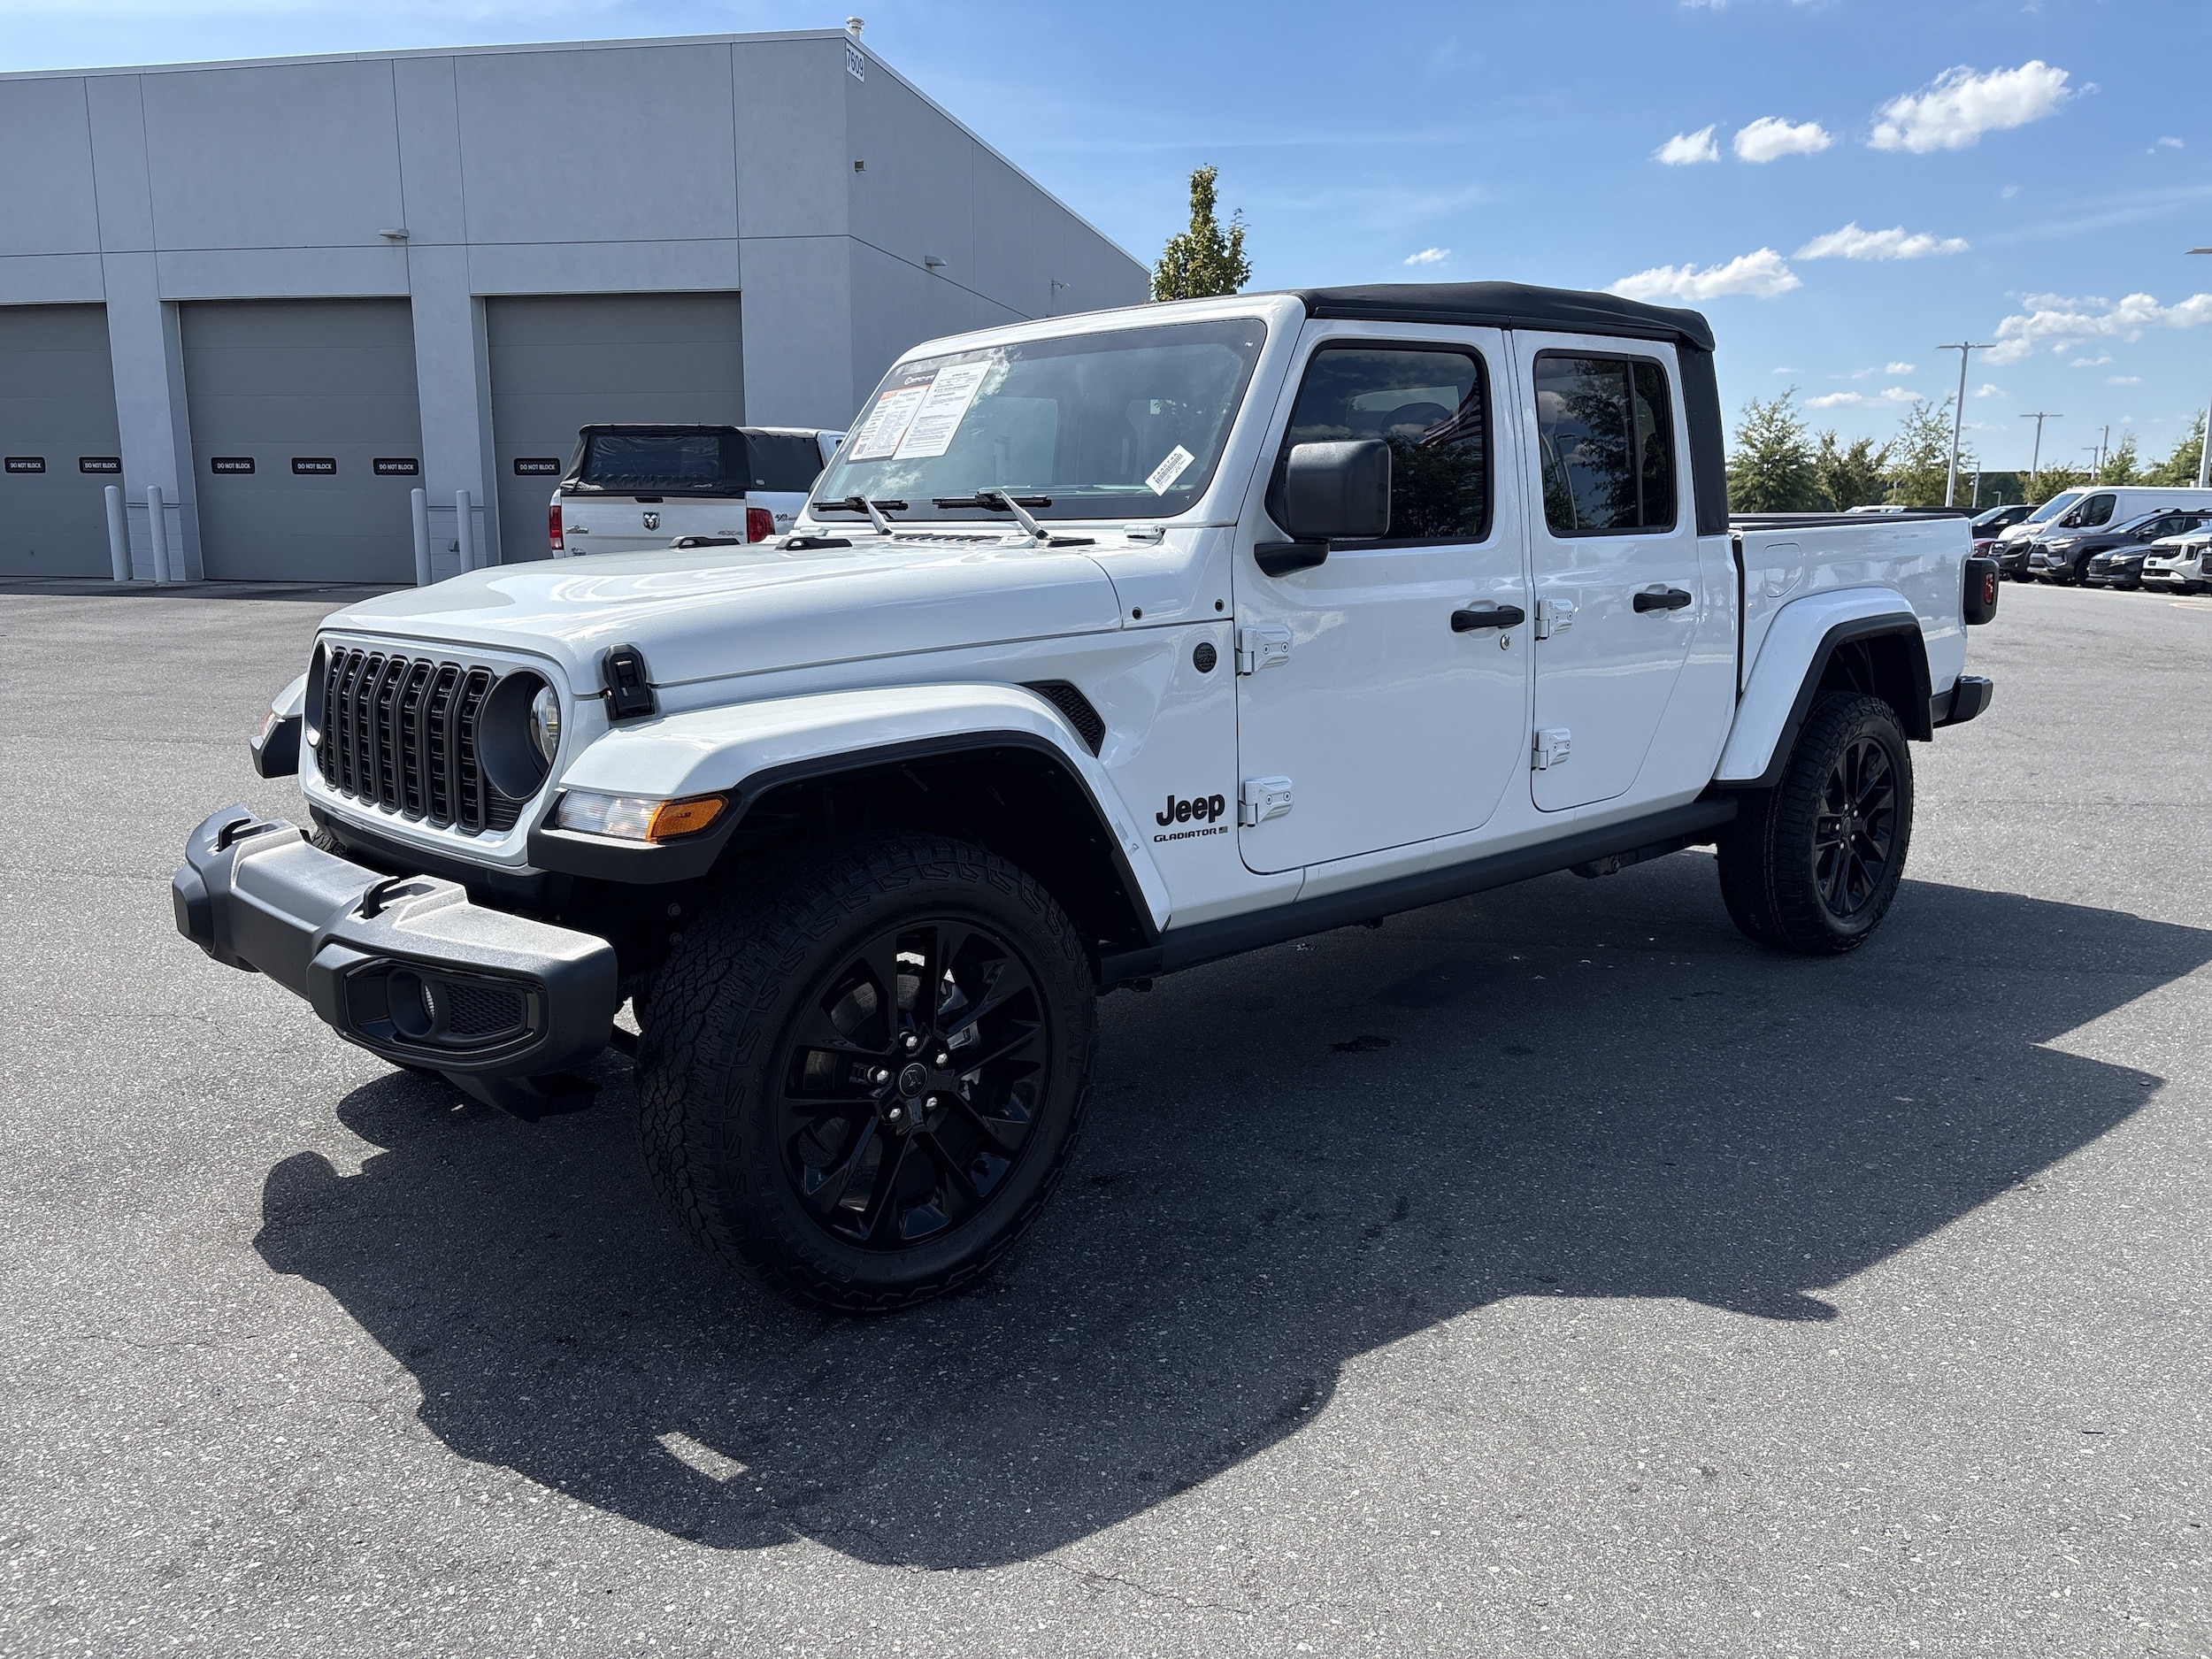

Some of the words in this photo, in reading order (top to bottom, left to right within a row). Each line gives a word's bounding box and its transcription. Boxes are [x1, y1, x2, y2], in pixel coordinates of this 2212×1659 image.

[847, 48, 864, 77] 7609
[1156, 794, 1225, 826] Jeep
[1153, 828, 1217, 842] GLADIATOR
